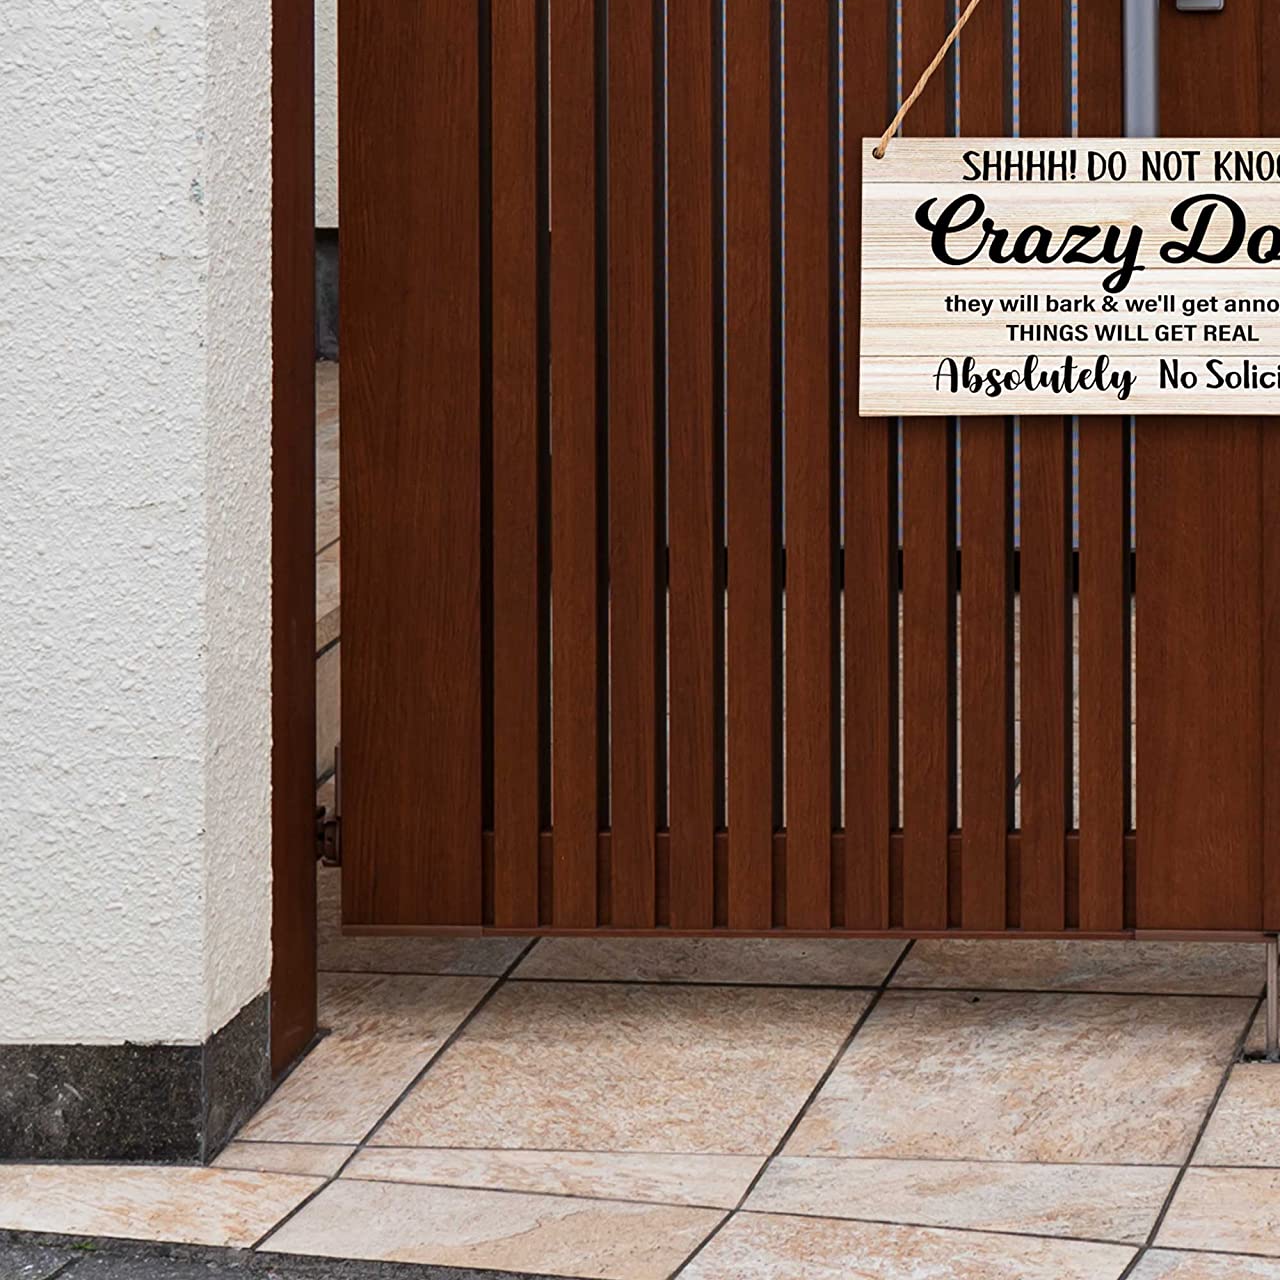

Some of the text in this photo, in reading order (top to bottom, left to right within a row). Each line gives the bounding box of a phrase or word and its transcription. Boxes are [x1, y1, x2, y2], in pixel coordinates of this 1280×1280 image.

[962, 150, 1077, 181] SHHHH!
[1087, 150, 1127, 182] DO
[1142, 150, 1201, 182] NOT
[914, 193, 1146, 294] Crazy
[944, 294, 994, 317] they
[1000, 294, 1039, 312] will
[1046, 294, 1096, 312] bark
[1101, 295, 1119, 313] &
[1125, 294, 1175, 313] we'll
[1182, 296, 1219, 317] get
[1005, 324, 1260, 342] THINGS WILL GET REAL
[932, 354, 1138, 401] Absolutely
[1159, 358, 1198, 389] No
